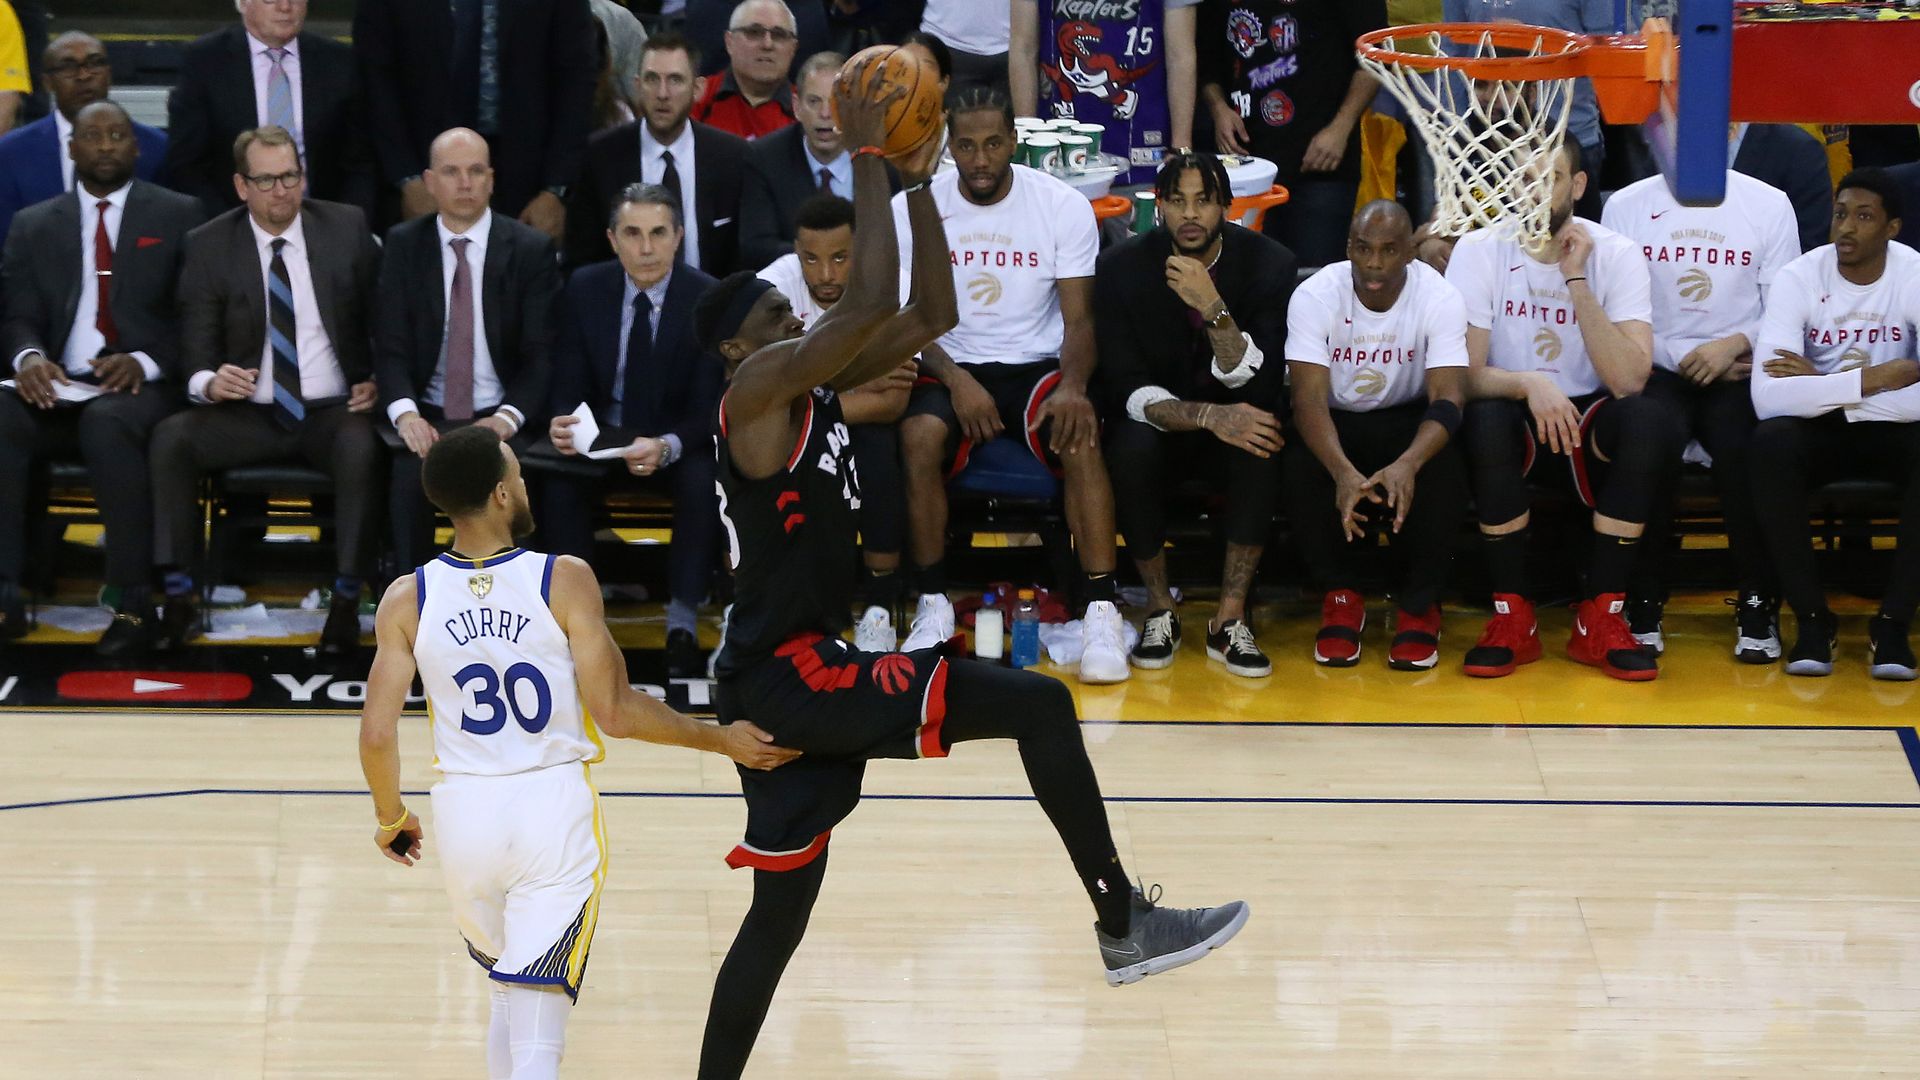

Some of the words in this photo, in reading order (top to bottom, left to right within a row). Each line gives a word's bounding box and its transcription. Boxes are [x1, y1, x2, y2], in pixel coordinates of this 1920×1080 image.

[1123, 26, 1154, 56] 15
[949, 250, 1039, 267] APTORS
[1643, 245, 1752, 266] RAPTORS
[445, 608, 531, 646] CURRY
[452, 662, 552, 735] 30
